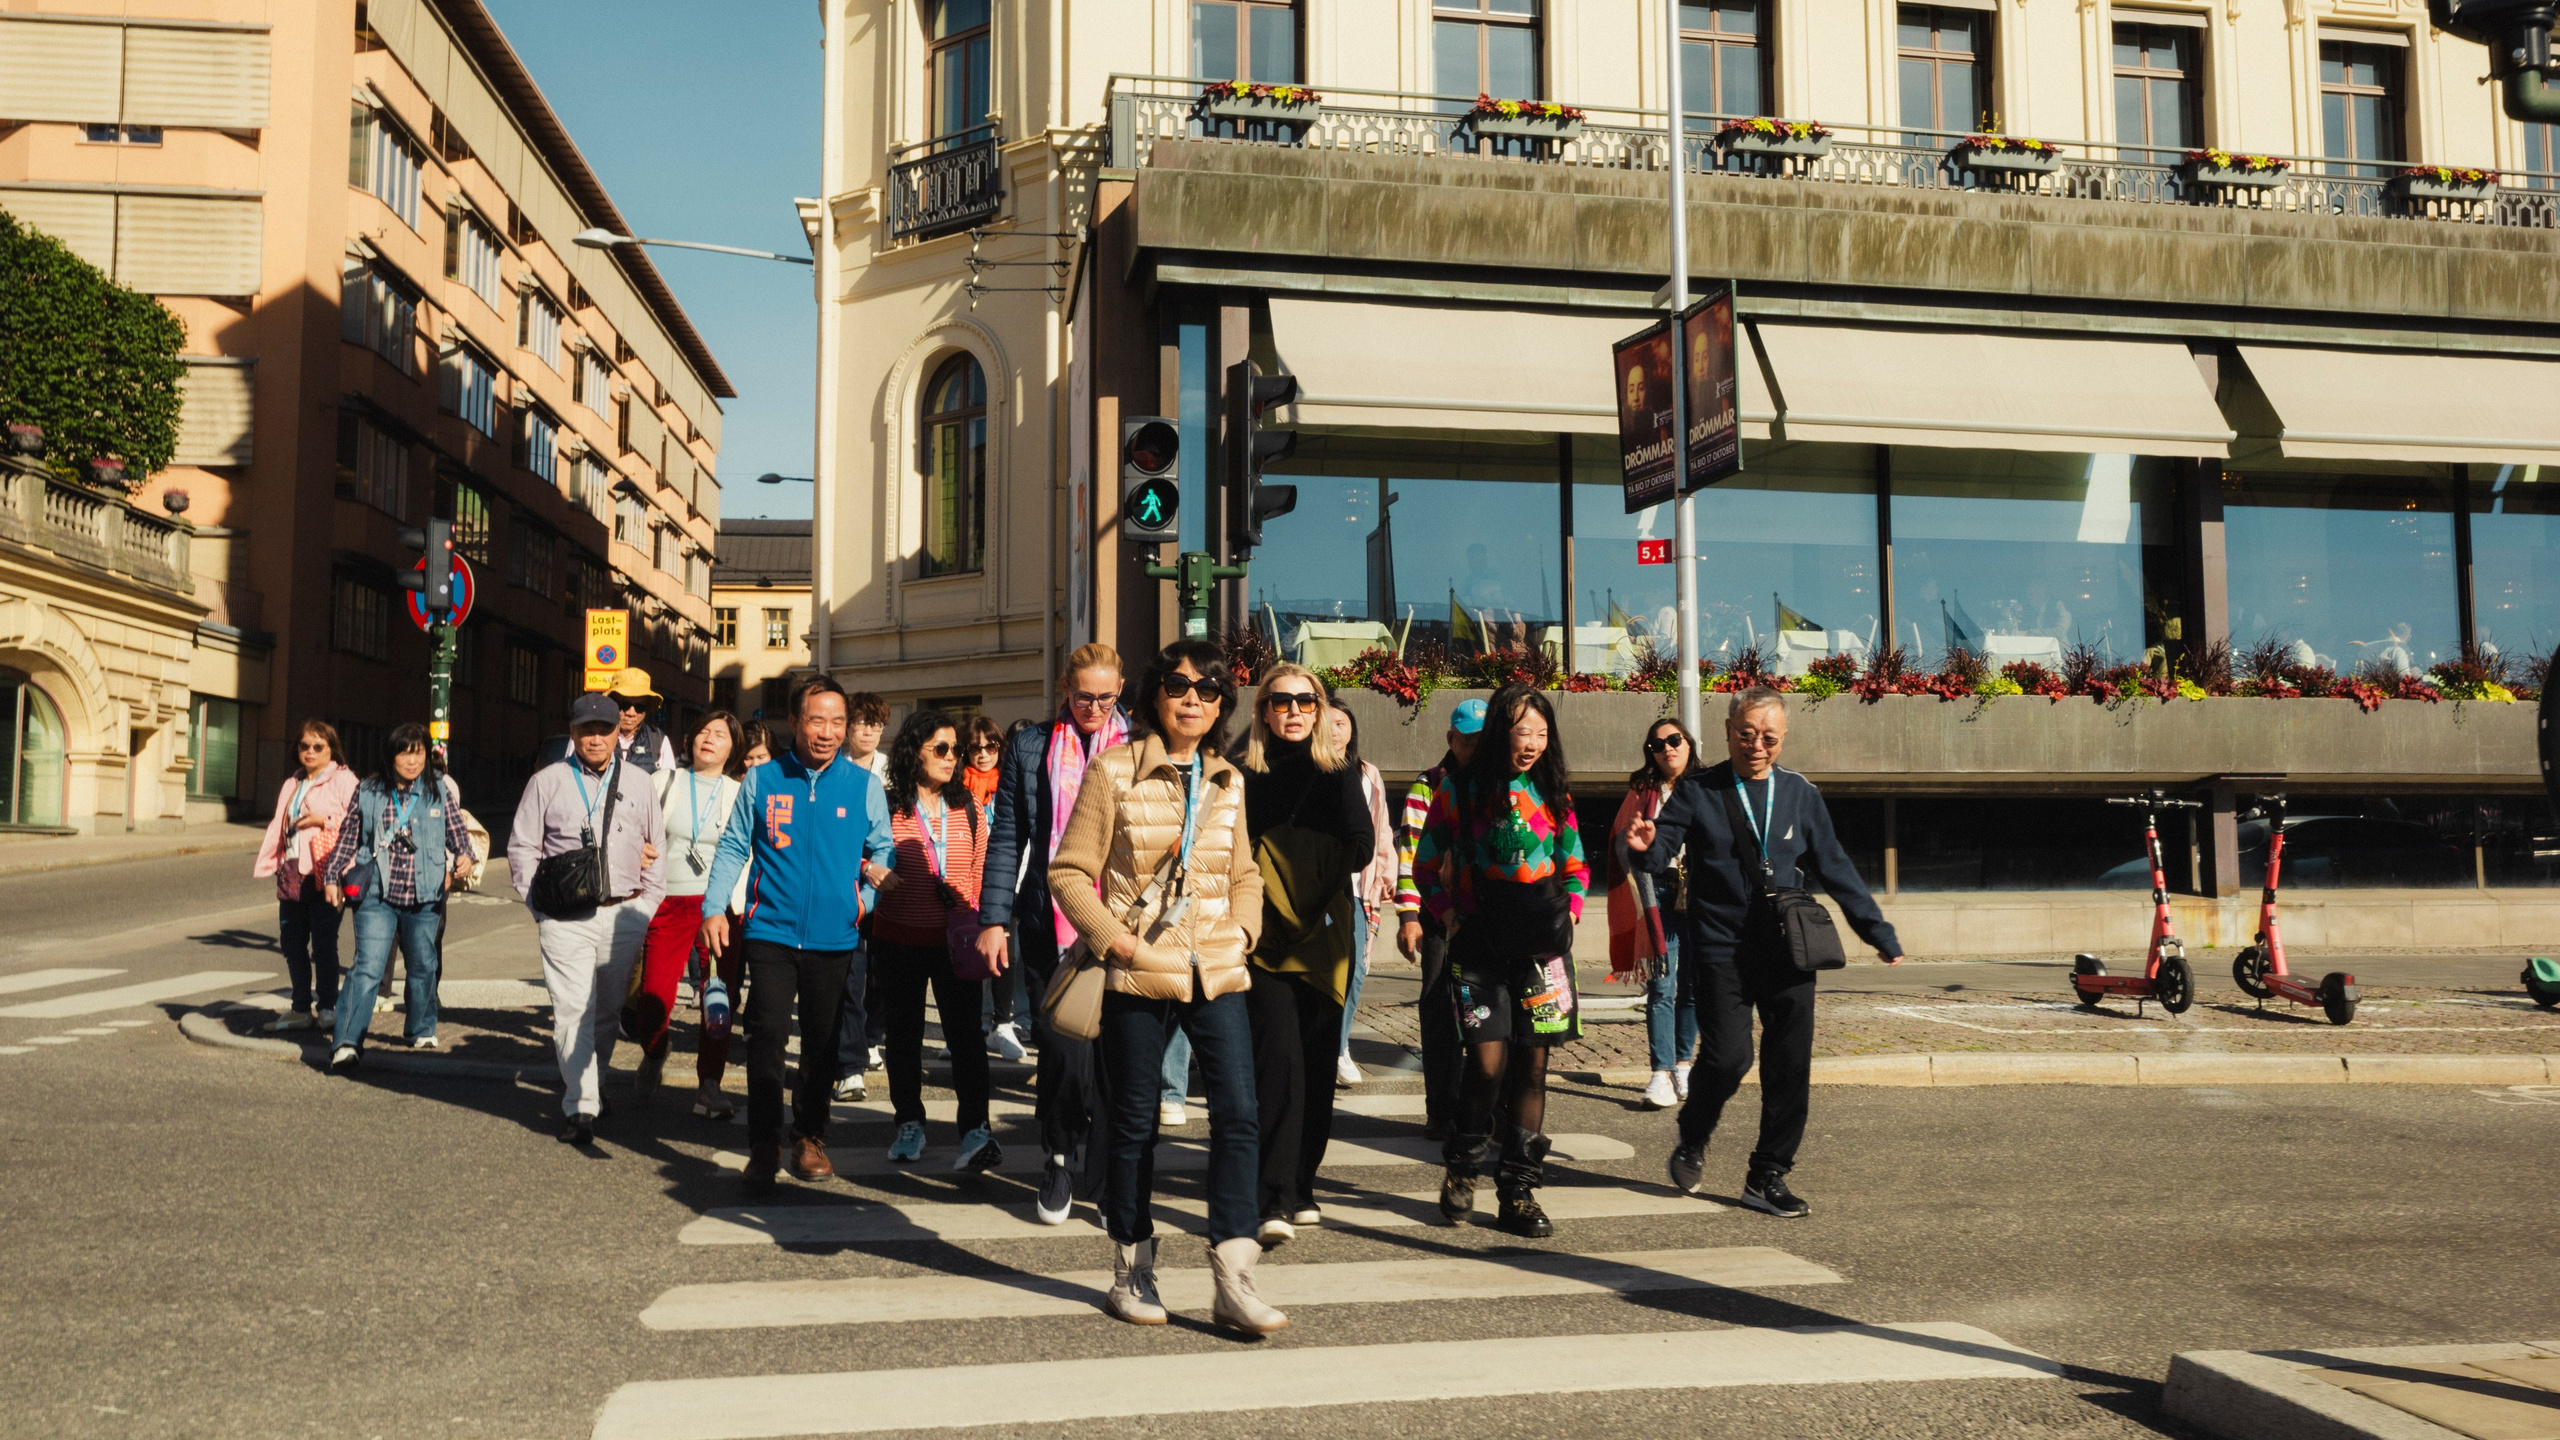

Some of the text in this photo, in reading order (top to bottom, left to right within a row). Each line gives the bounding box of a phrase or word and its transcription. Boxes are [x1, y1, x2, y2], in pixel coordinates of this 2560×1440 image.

[1689, 408, 1735, 445] DRÖMMAR
[1624, 438, 1674, 471] DRÖMMAR
[1712, 443, 1735, 461] OKTOBER
[1635, 481, 1644, 492] BIO
[1644, 479, 1650, 490] 17
[1650, 470, 1675, 486] OKTOBER
[1641, 545, 1665, 561] 5,1
[592, 615, 622, 624] Last-
[592, 626, 621, 637] plats
[766, 794, 775, 828] SPORT
[775, 794, 793, 849] FILA
